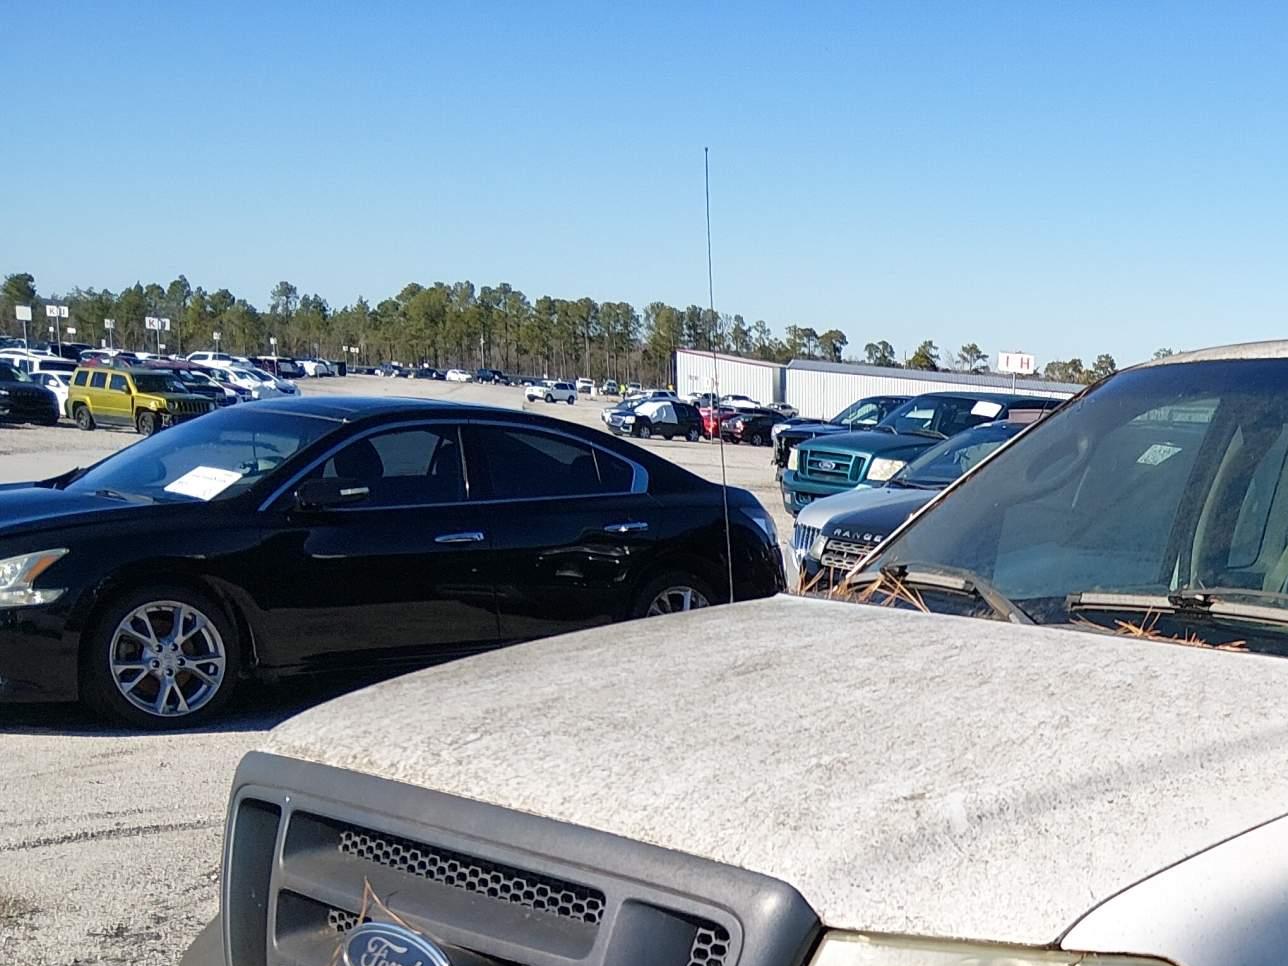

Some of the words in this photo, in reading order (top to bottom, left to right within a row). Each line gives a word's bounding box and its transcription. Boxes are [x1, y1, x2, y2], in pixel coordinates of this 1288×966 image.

[148, 319, 155, 328] K
[1020, 356, 1030, 370] H
[833, 528, 884, 543] RANGE
